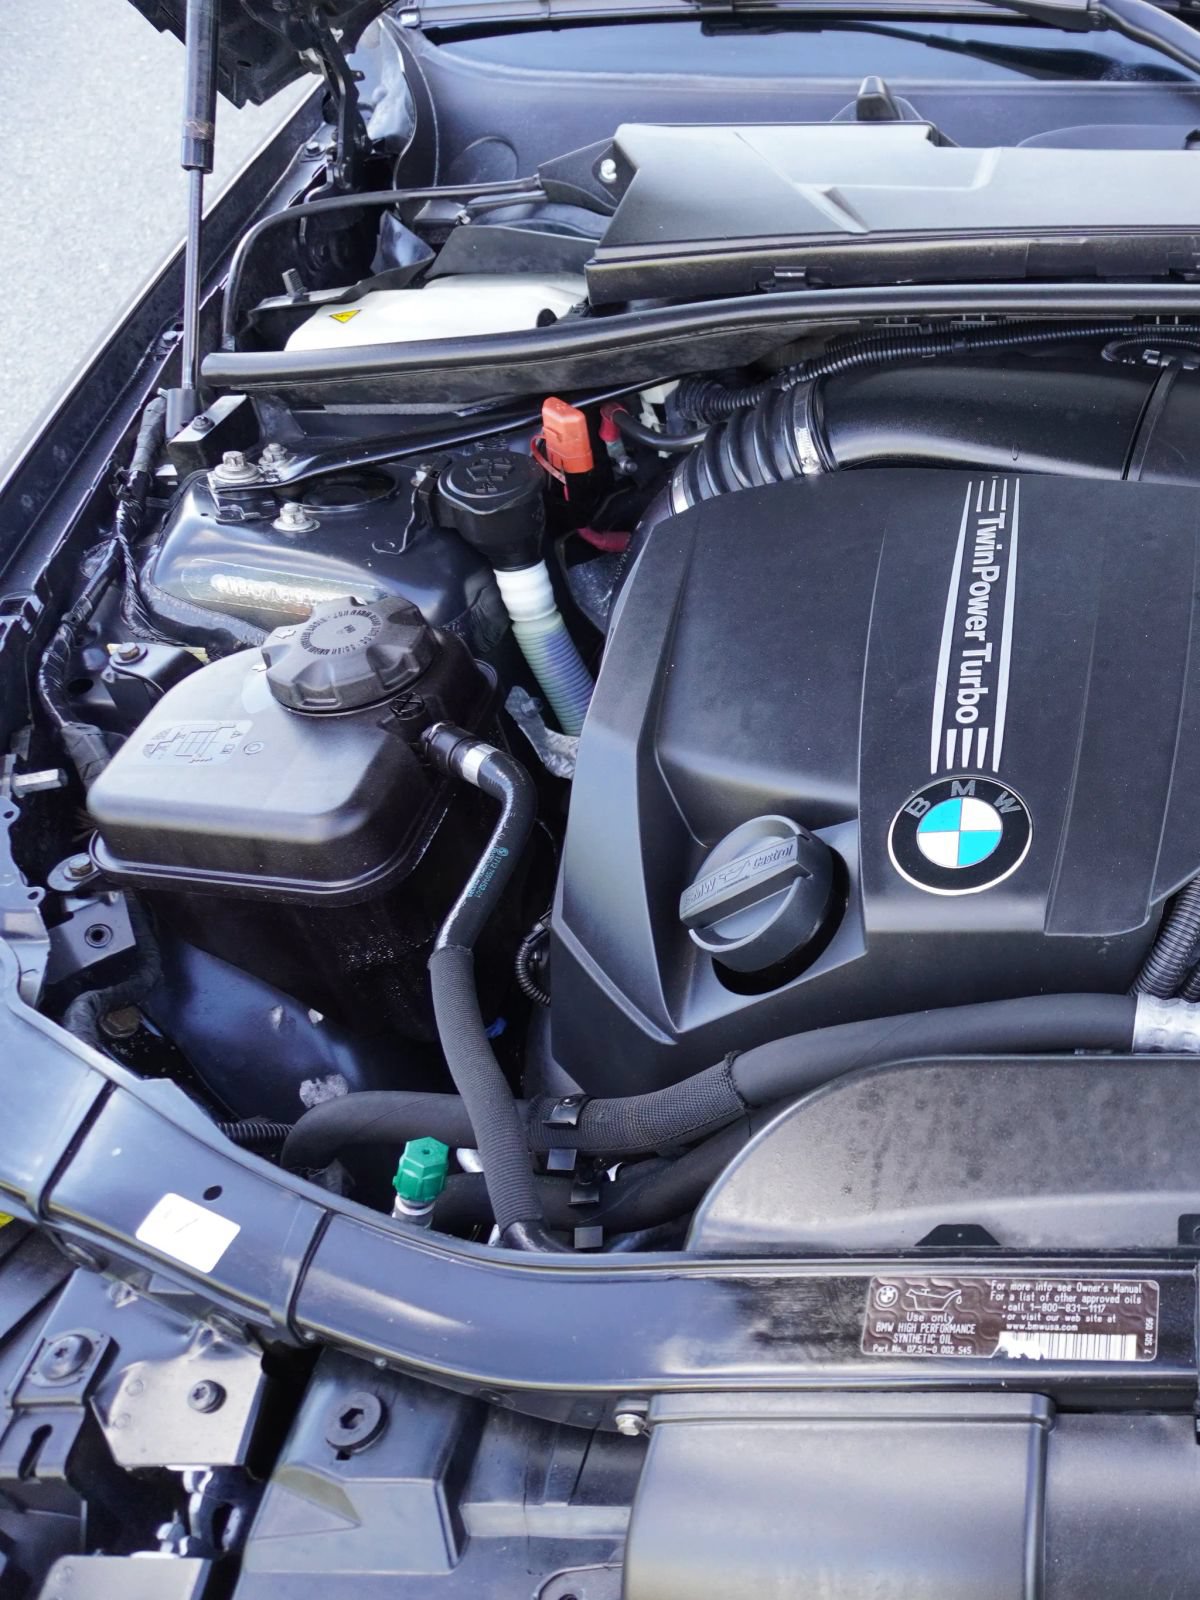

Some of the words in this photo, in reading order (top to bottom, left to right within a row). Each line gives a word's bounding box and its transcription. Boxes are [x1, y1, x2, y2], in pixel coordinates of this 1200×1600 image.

[964, 512, 1006, 641] TwinPower
[955, 642, 993, 724] Turbo
[904, 779, 1022, 818] BMW
[991, 1280, 1006, 1290] For
[1010, 1282, 1031, 1291] more
[1035, 1281, 1053, 1291] info
[1057, 1283, 1072, 1292] see
[1076, 1281, 1109, 1293] Owner's
[1113, 1283, 1142, 1294] Manual
[990, 1290, 1005, 1301] For
[1009, 1293, 1015, 1301] a
[1019, 1291, 1035, 1301] list
[1040, 1291, 1051, 1302] of
[1054, 1292, 1077, 1303] other
[1081, 1293, 1120, 1305] approved
[1124, 1294, 1142, 1304] oils
[1029, 1302, 1106, 1313] 1-800-831-1117
[906, 1311, 925, 1322] Use
[931, 1312, 954, 1324] only
[1021, 1312, 1041, 1321] visit
[1045, 1314, 1060, 1322] our
[1064, 1313, 1081, 1322] web
[1085, 1313, 1103, 1323] site
[1107, 1313, 1117, 1323] at
[875, 1322, 894, 1332] BMW
[897, 1322, 917, 1333] HIGH
[920, 1323, 976, 1334] PERFORMANCE
[1006, 1321, 1078, 1331] www.bmwusa.com
[892, 1333, 936, 1344] SYNTHETIC
[939, 1334, 953, 1344] OIL
[872, 1344, 889, 1353] Part
[892, 1344, 904, 1353] No.
